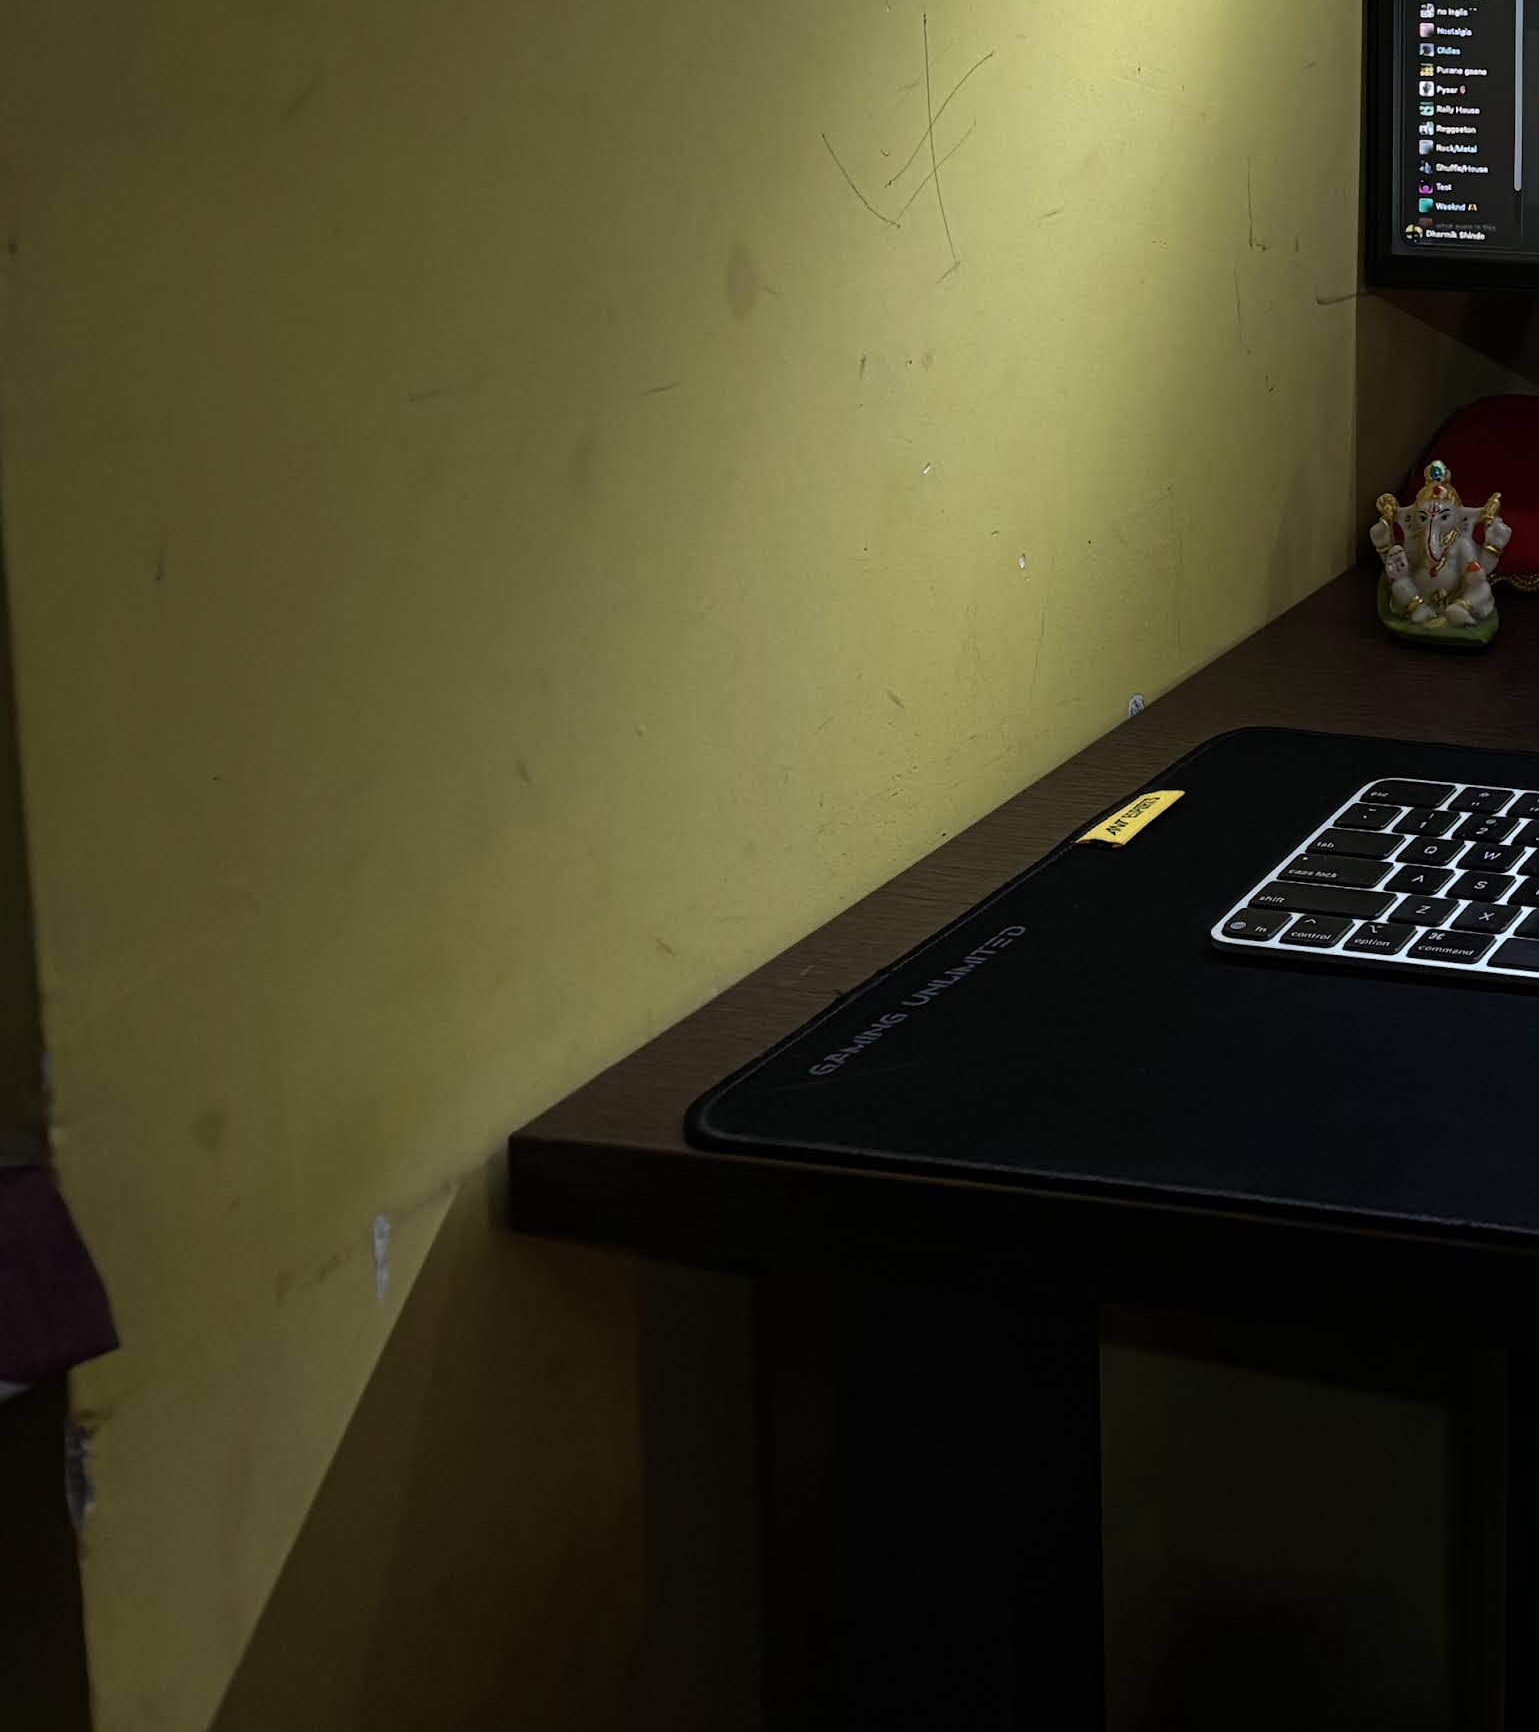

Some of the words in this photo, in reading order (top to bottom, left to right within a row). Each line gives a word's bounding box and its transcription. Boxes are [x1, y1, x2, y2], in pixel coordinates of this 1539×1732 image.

[1426, 230, 1457, 238] Dharmik
[1459, 231, 1485, 240] Shinde
[1418, 946, 1474, 955] command
[809, 1011, 909, 1077] GAMING
[902, 925, 1026, 1007] UNLIMITED
